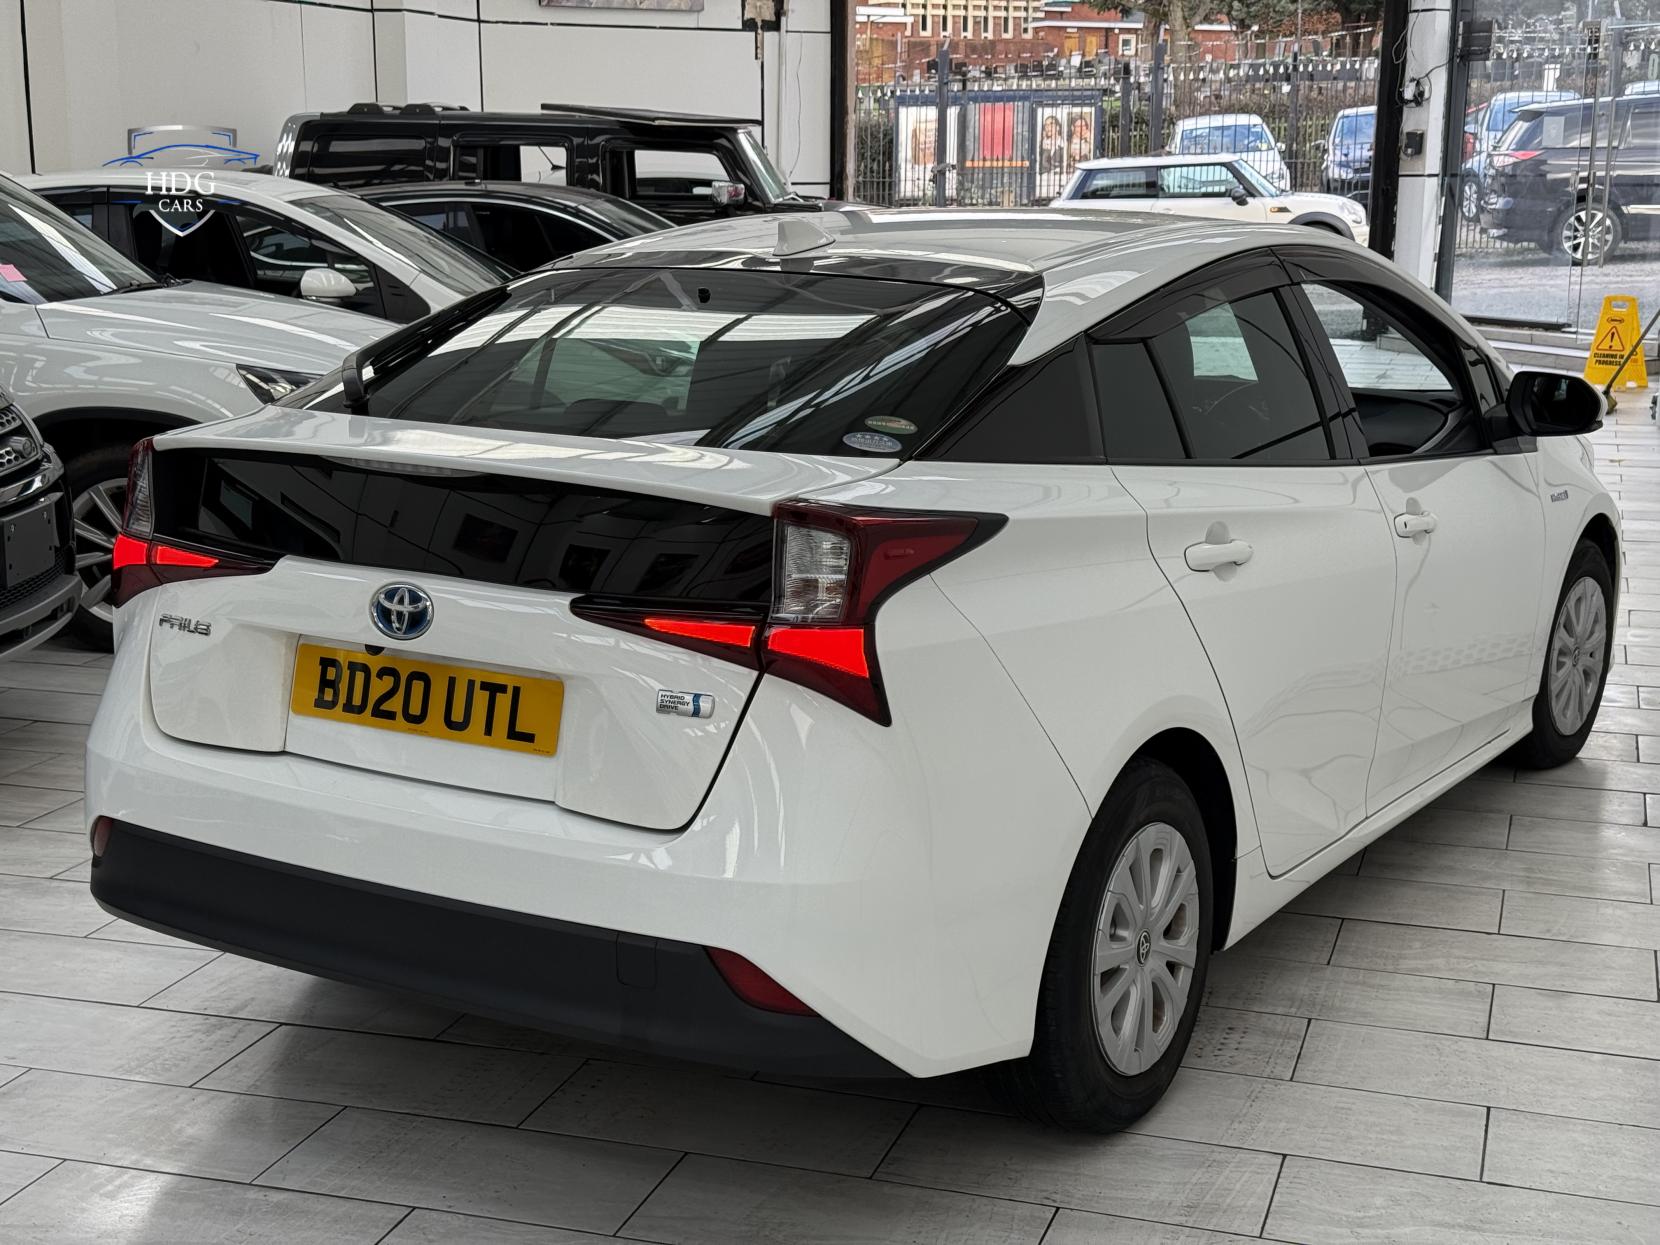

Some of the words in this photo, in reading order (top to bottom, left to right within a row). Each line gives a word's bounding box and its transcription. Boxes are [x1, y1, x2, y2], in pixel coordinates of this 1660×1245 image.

[1593, 352, 1618, 360] CLEANING
[159, 611, 212, 636] PRIUS
[313, 656, 431, 725] BD20
[443, 676, 536, 744] UTL
